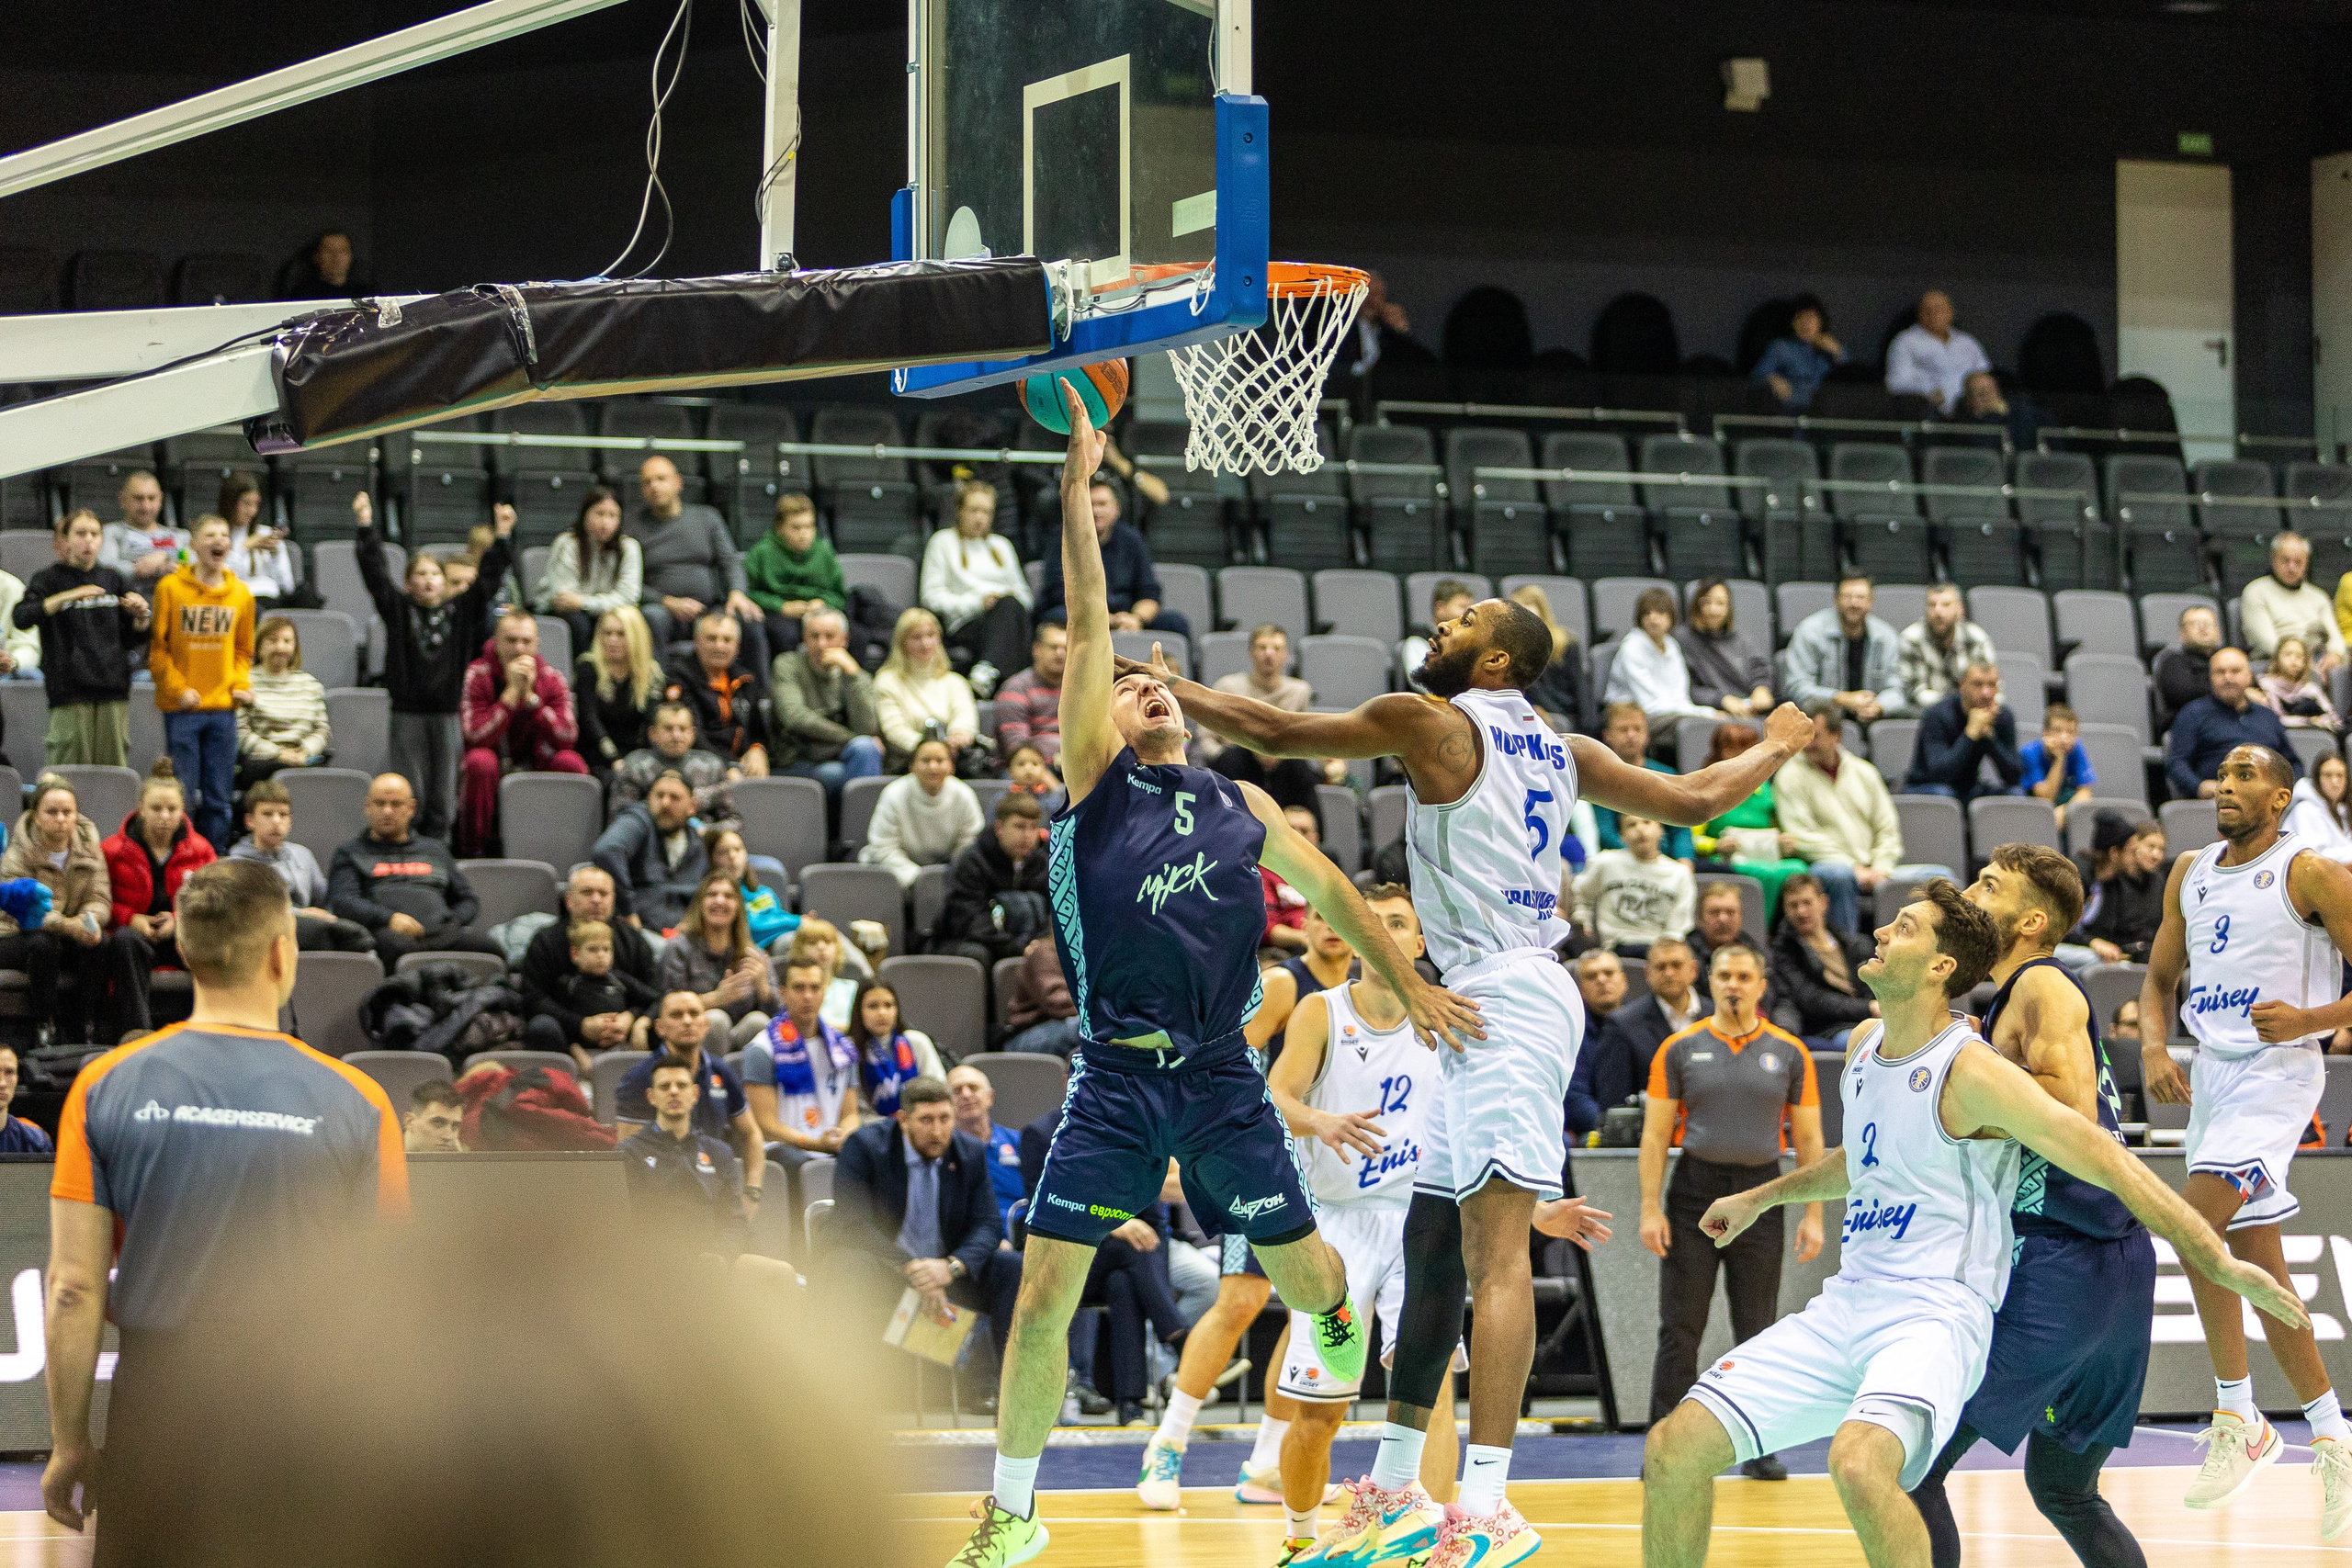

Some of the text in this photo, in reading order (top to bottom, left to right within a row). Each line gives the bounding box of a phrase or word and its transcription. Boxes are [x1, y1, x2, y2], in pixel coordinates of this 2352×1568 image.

[180, 605, 236, 636] NEW
[1127, 773, 1162, 795] Kempa
[1174, 792, 1196, 836] 5
[1524, 788, 1555, 863] 5
[2210, 915, 2231, 953] 3
[1380, 1075, 1412, 1116] 12
[1358, 1138, 1419, 1189] Enis
[1860, 1122, 1879, 1168] 2
[1047, 1192, 1086, 1213] Kempa
